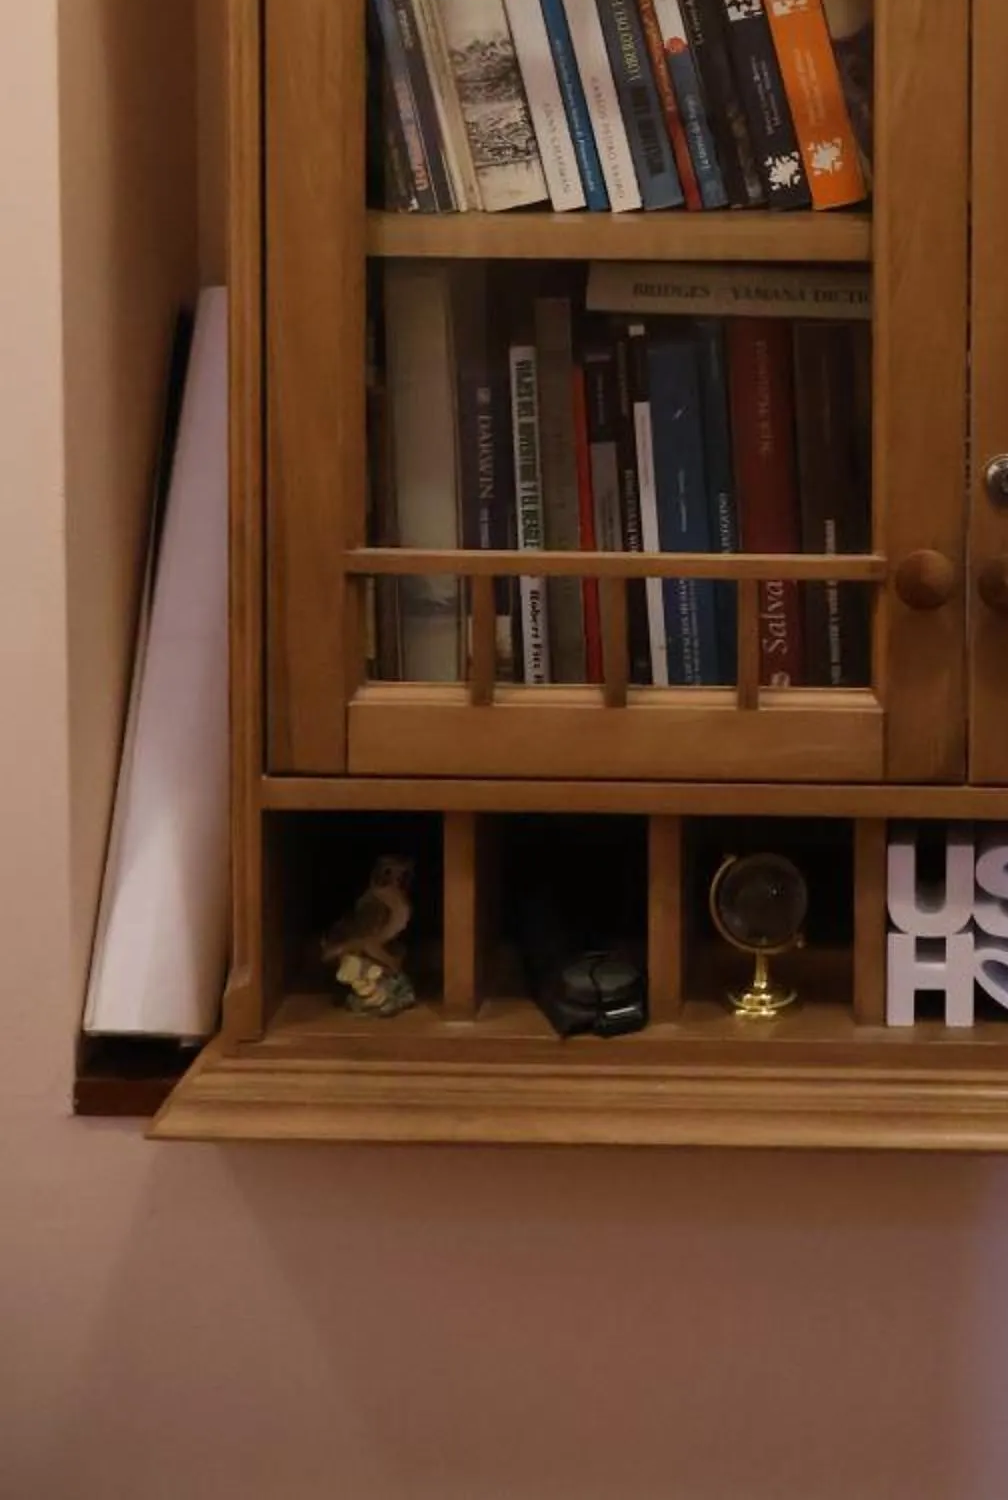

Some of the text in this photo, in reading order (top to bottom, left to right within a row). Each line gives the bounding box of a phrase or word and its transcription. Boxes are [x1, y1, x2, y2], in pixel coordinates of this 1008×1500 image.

[632, 281, 711, 299] BRIDGES
[812, 285, 870, 306] DICTI
[477, 415, 495, 501] DARWIN
[761, 580, 788, 654] Salva
